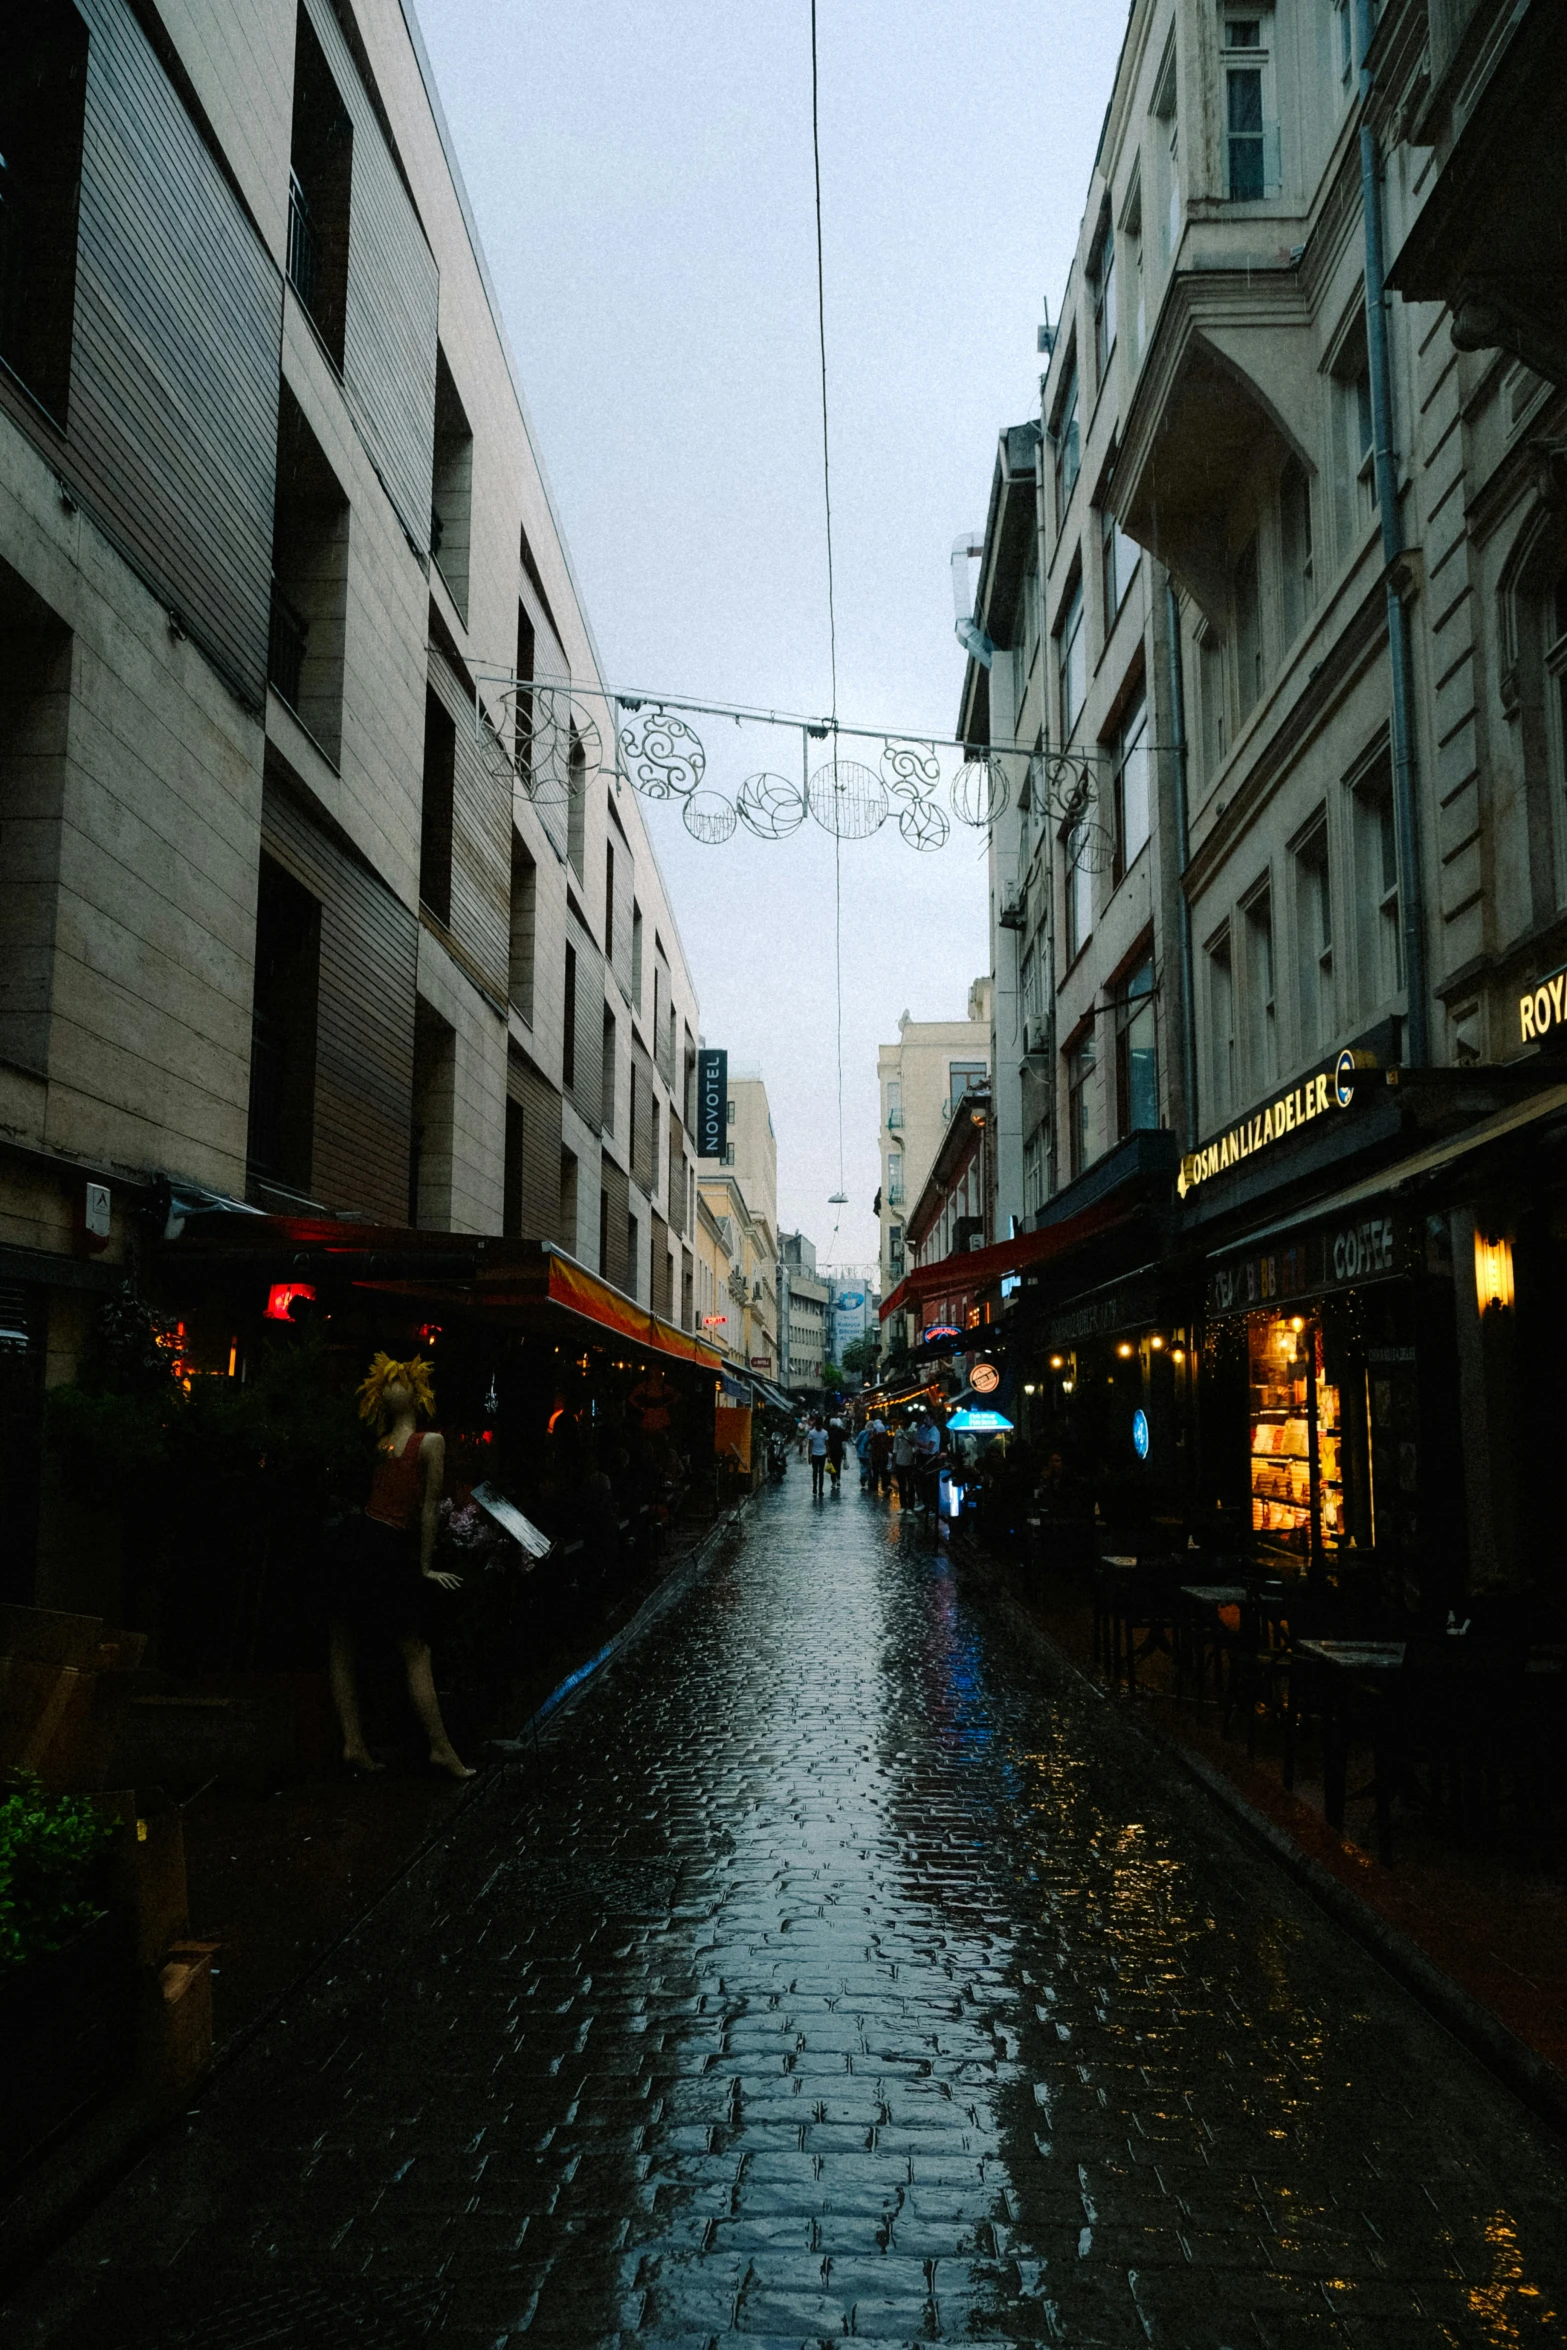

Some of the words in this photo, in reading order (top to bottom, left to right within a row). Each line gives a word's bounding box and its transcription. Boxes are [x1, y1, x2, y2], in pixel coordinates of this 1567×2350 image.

[1519, 972, 1567, 1043] ROY
[705, 1056, 720, 1151] NOVOTEL
[1192, 1073, 1330, 1185] OSMANLIZADELER
[1333, 1217, 1394, 1279] COFFEE
